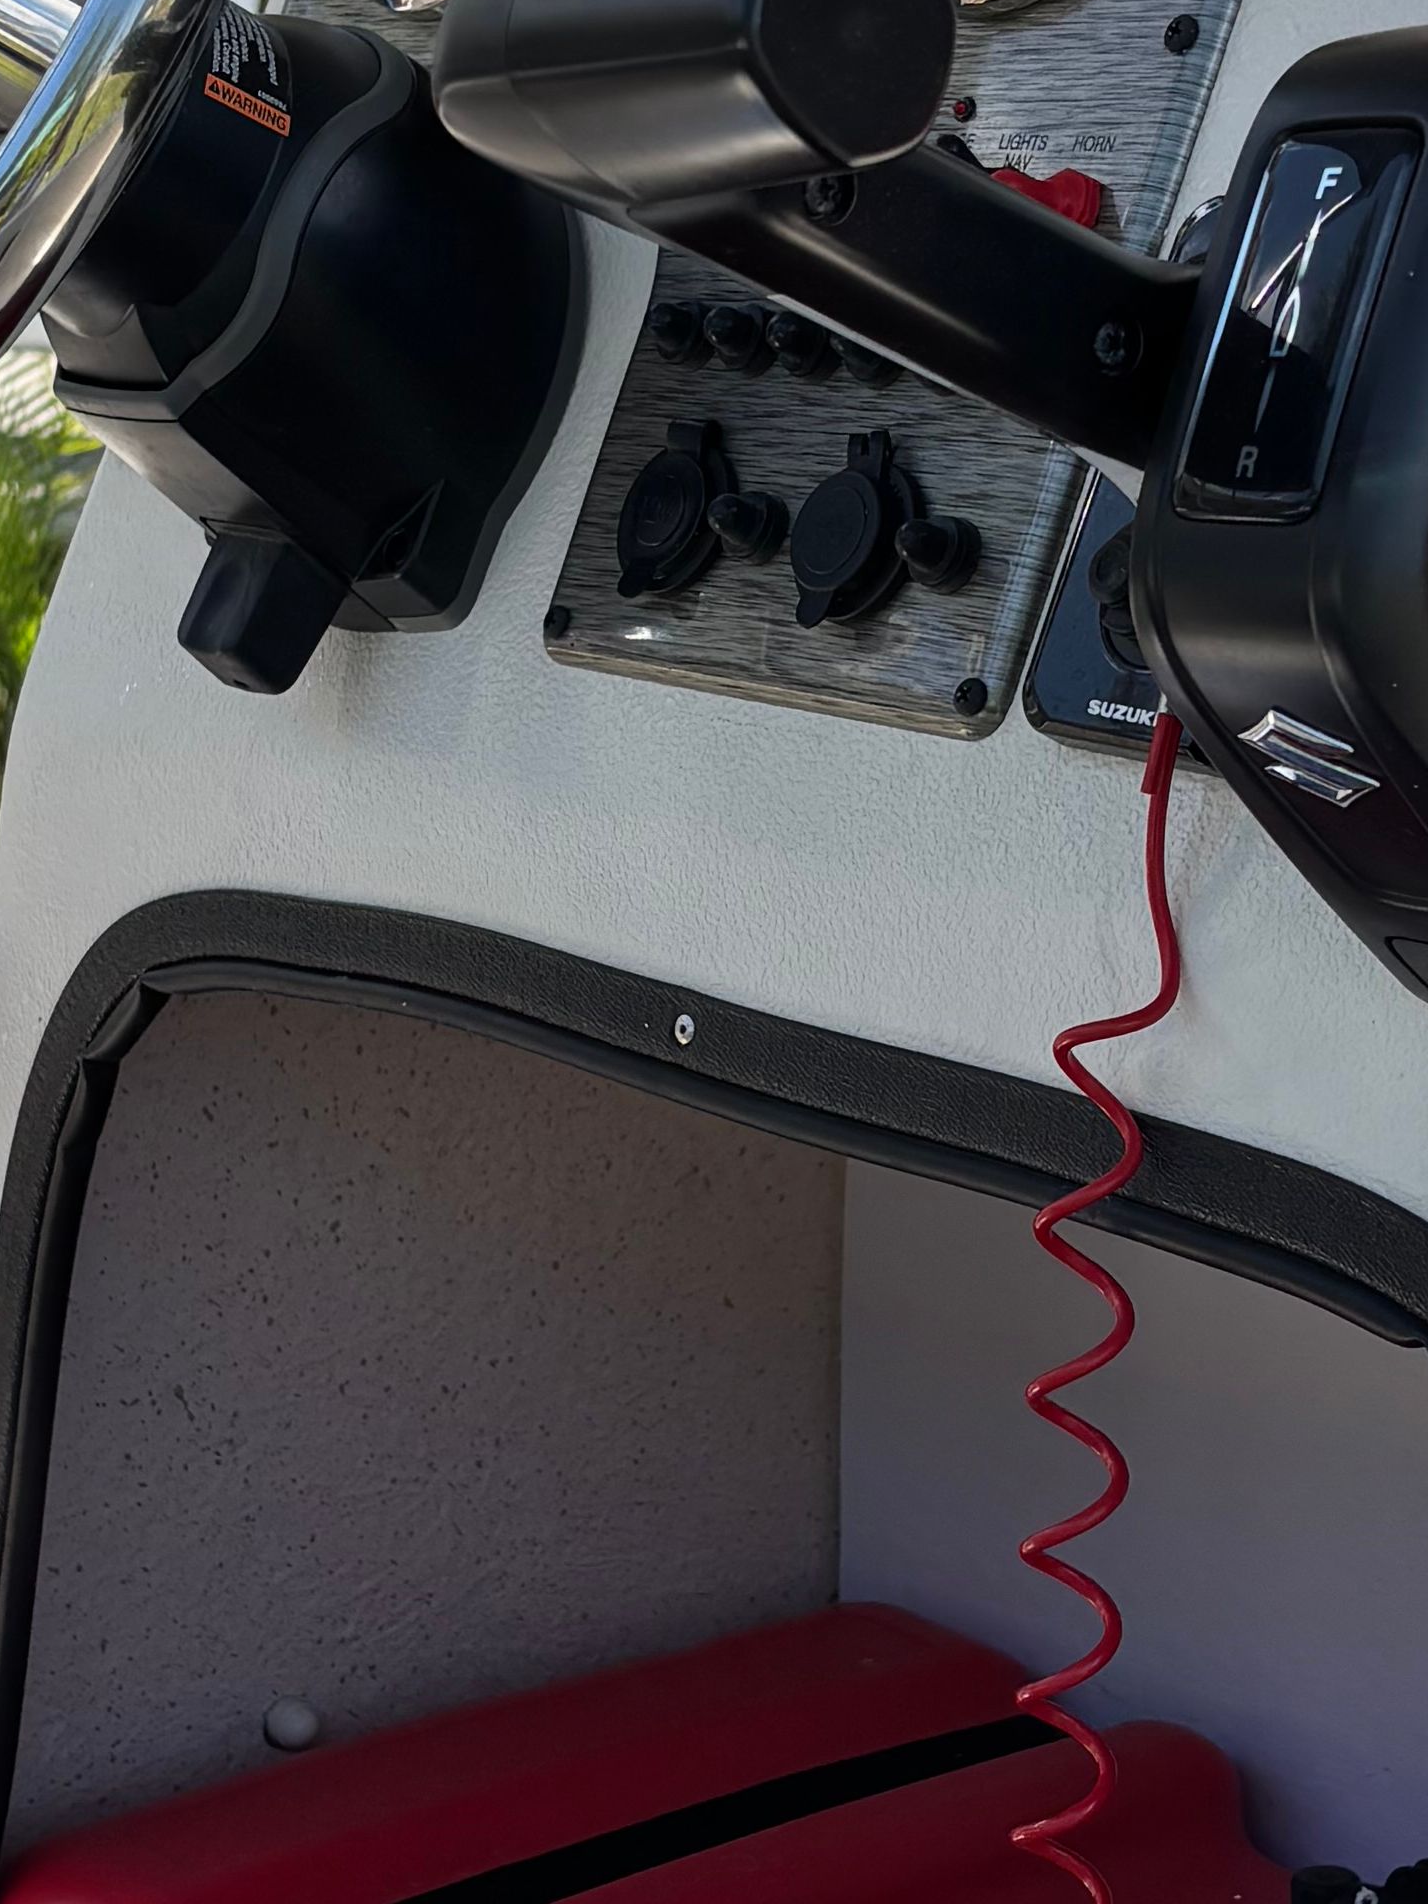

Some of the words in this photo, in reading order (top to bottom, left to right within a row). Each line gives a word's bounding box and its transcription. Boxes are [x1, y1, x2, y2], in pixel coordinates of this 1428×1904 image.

[222, 84, 287, 132] WARNING
[998, 133, 1049, 151] LIGHTS
[1072, 135, 1117, 153] HORN
[1004, 153, 1034, 172] NAV
[1315, 167, 1343, 199] F
[1235, 446, 1259, 478] R
